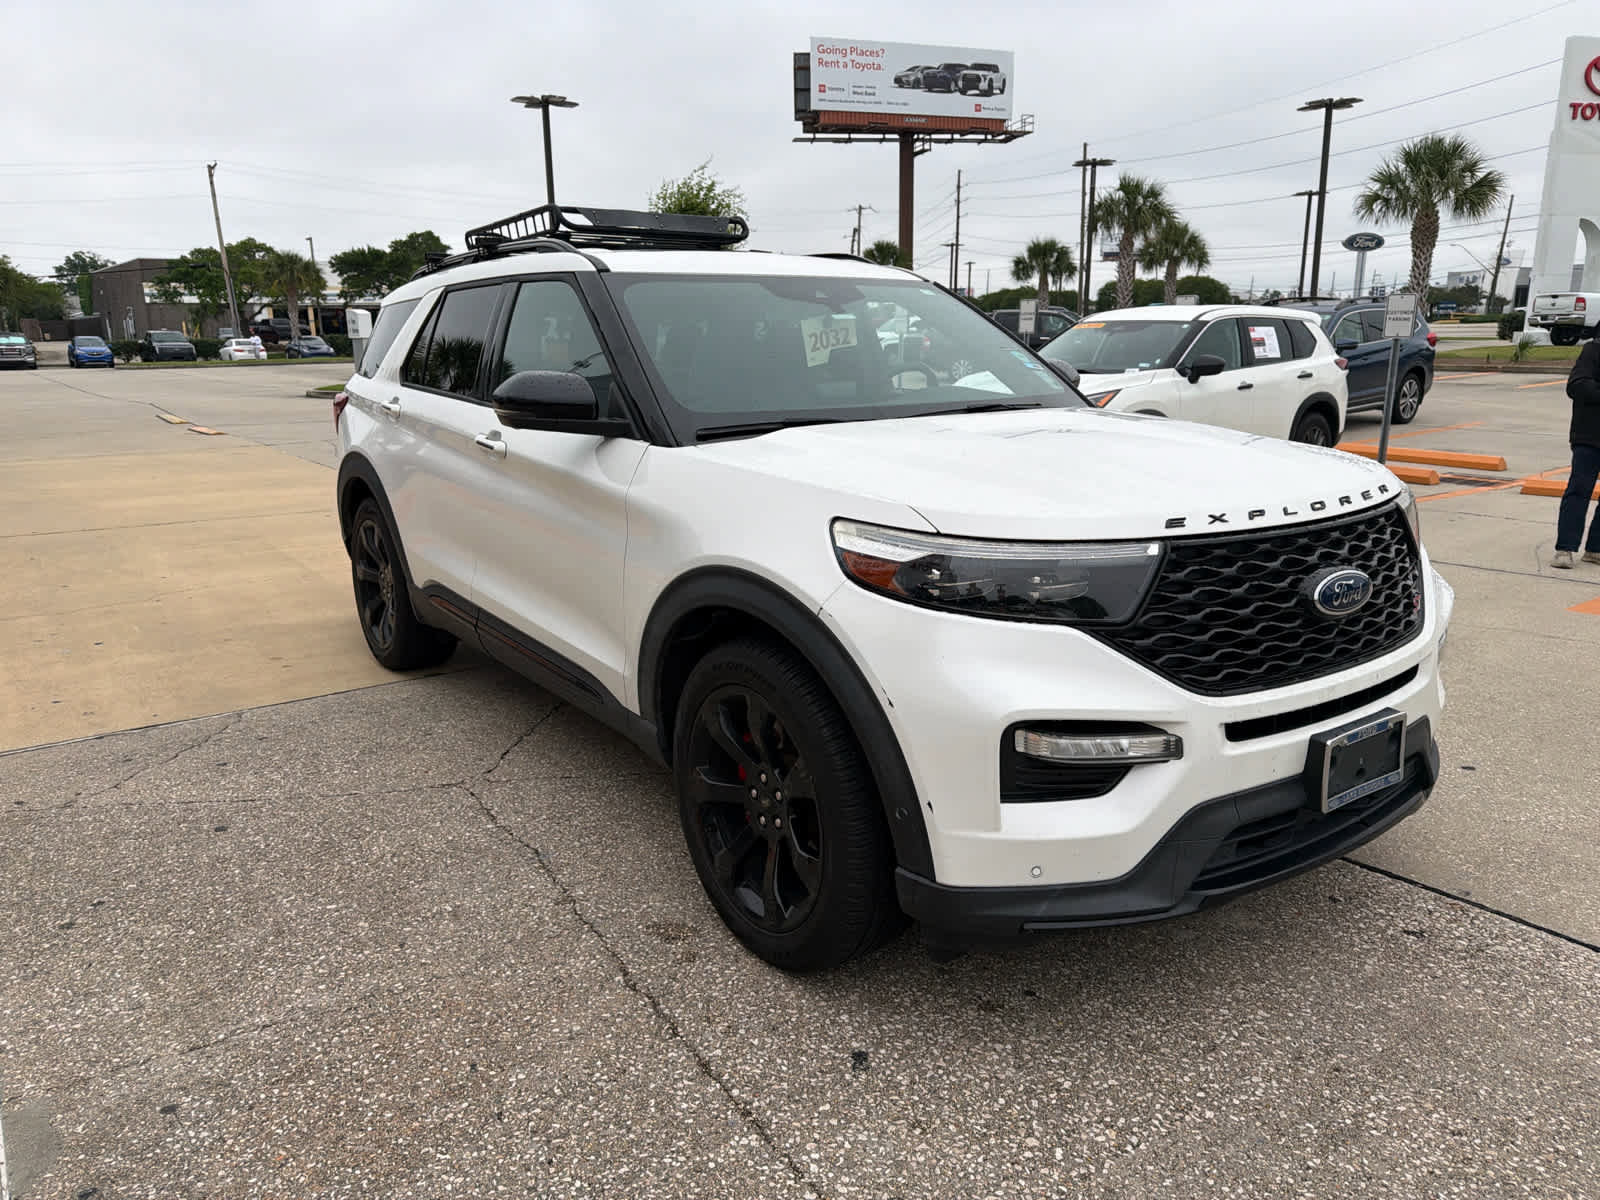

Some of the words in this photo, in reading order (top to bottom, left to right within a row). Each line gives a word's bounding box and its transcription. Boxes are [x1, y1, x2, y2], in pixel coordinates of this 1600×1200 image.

[817, 44, 848, 58] Going
[849, 46, 885, 59] Places?
[818, 57, 840, 69] Rent
[842, 61, 848, 69] a
[850, 58, 884, 72] Toyota.
[1165, 484, 1389, 529] EXPLORER
[1332, 579, 1364, 606] Ford
